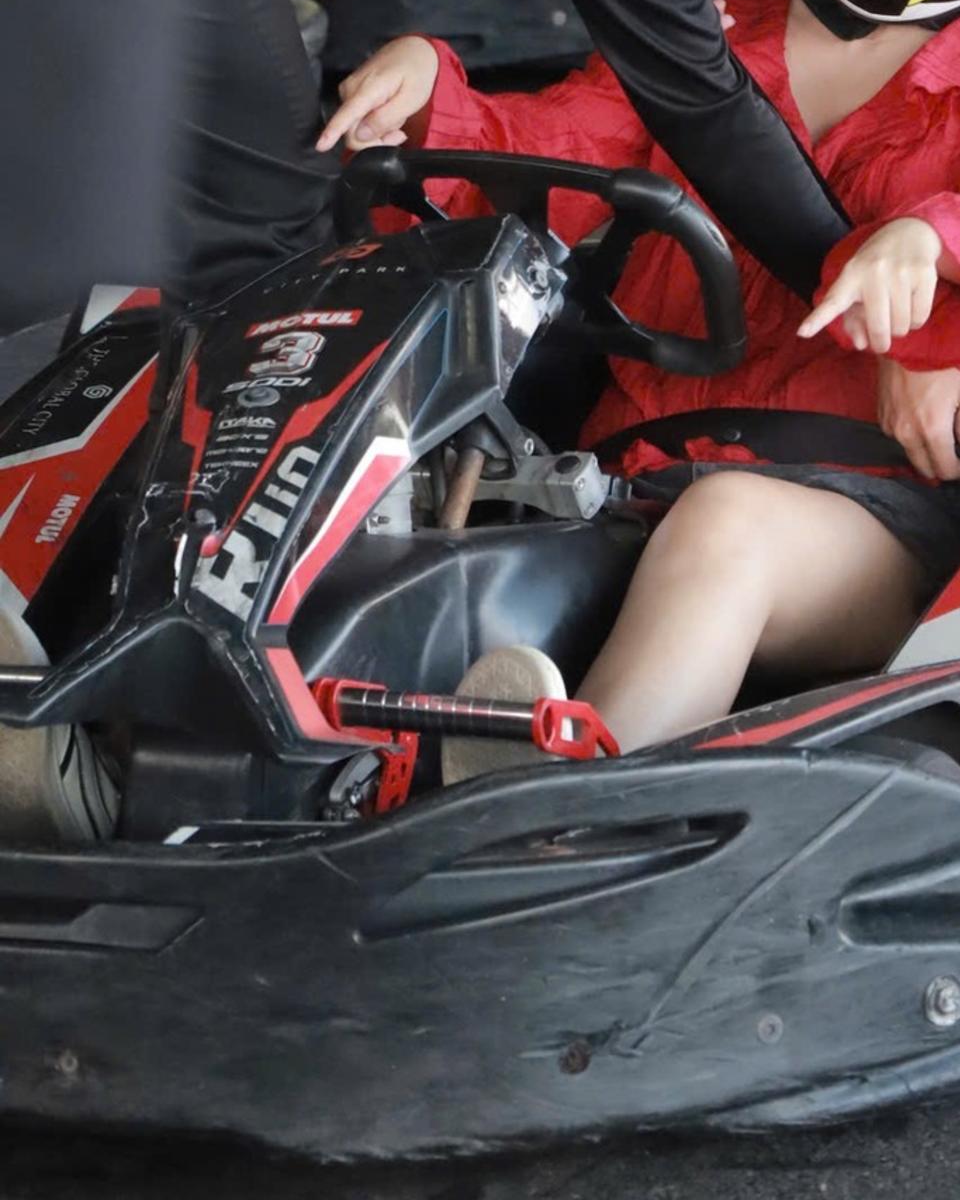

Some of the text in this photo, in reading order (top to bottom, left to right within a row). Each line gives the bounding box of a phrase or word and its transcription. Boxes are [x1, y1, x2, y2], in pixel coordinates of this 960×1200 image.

[253, 312, 354, 337] MOTUL
[248, 330, 327, 377] 3
[221, 376, 312, 393] SODI
[34, 493, 81, 544] MOTUL
